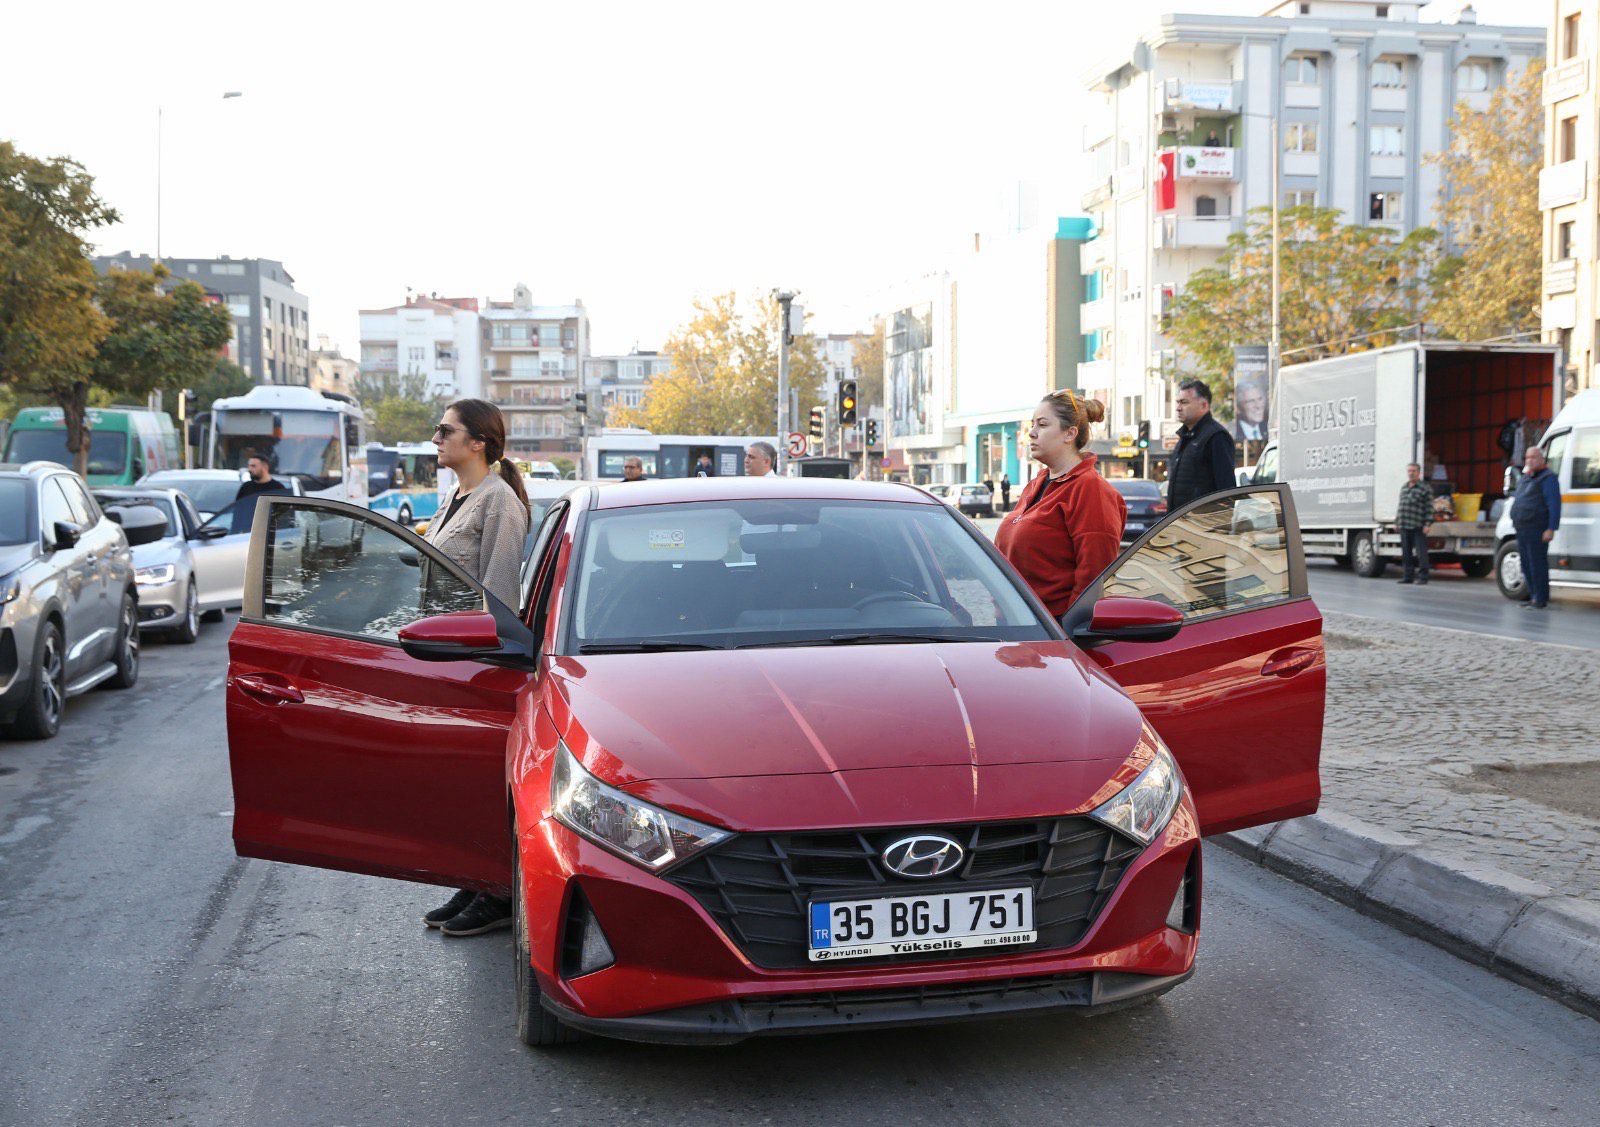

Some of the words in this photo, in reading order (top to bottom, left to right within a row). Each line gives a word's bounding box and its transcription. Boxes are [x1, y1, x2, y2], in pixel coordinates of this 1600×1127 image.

[1290, 397, 1357, 435] SUBAŞI
[814, 929, 829, 940] TR
[833, 904, 875, 942] 35
[890, 898, 951, 938] BGJ
[968, 892, 1024, 931] 751
[833, 948, 873, 957] HYUNDAI
